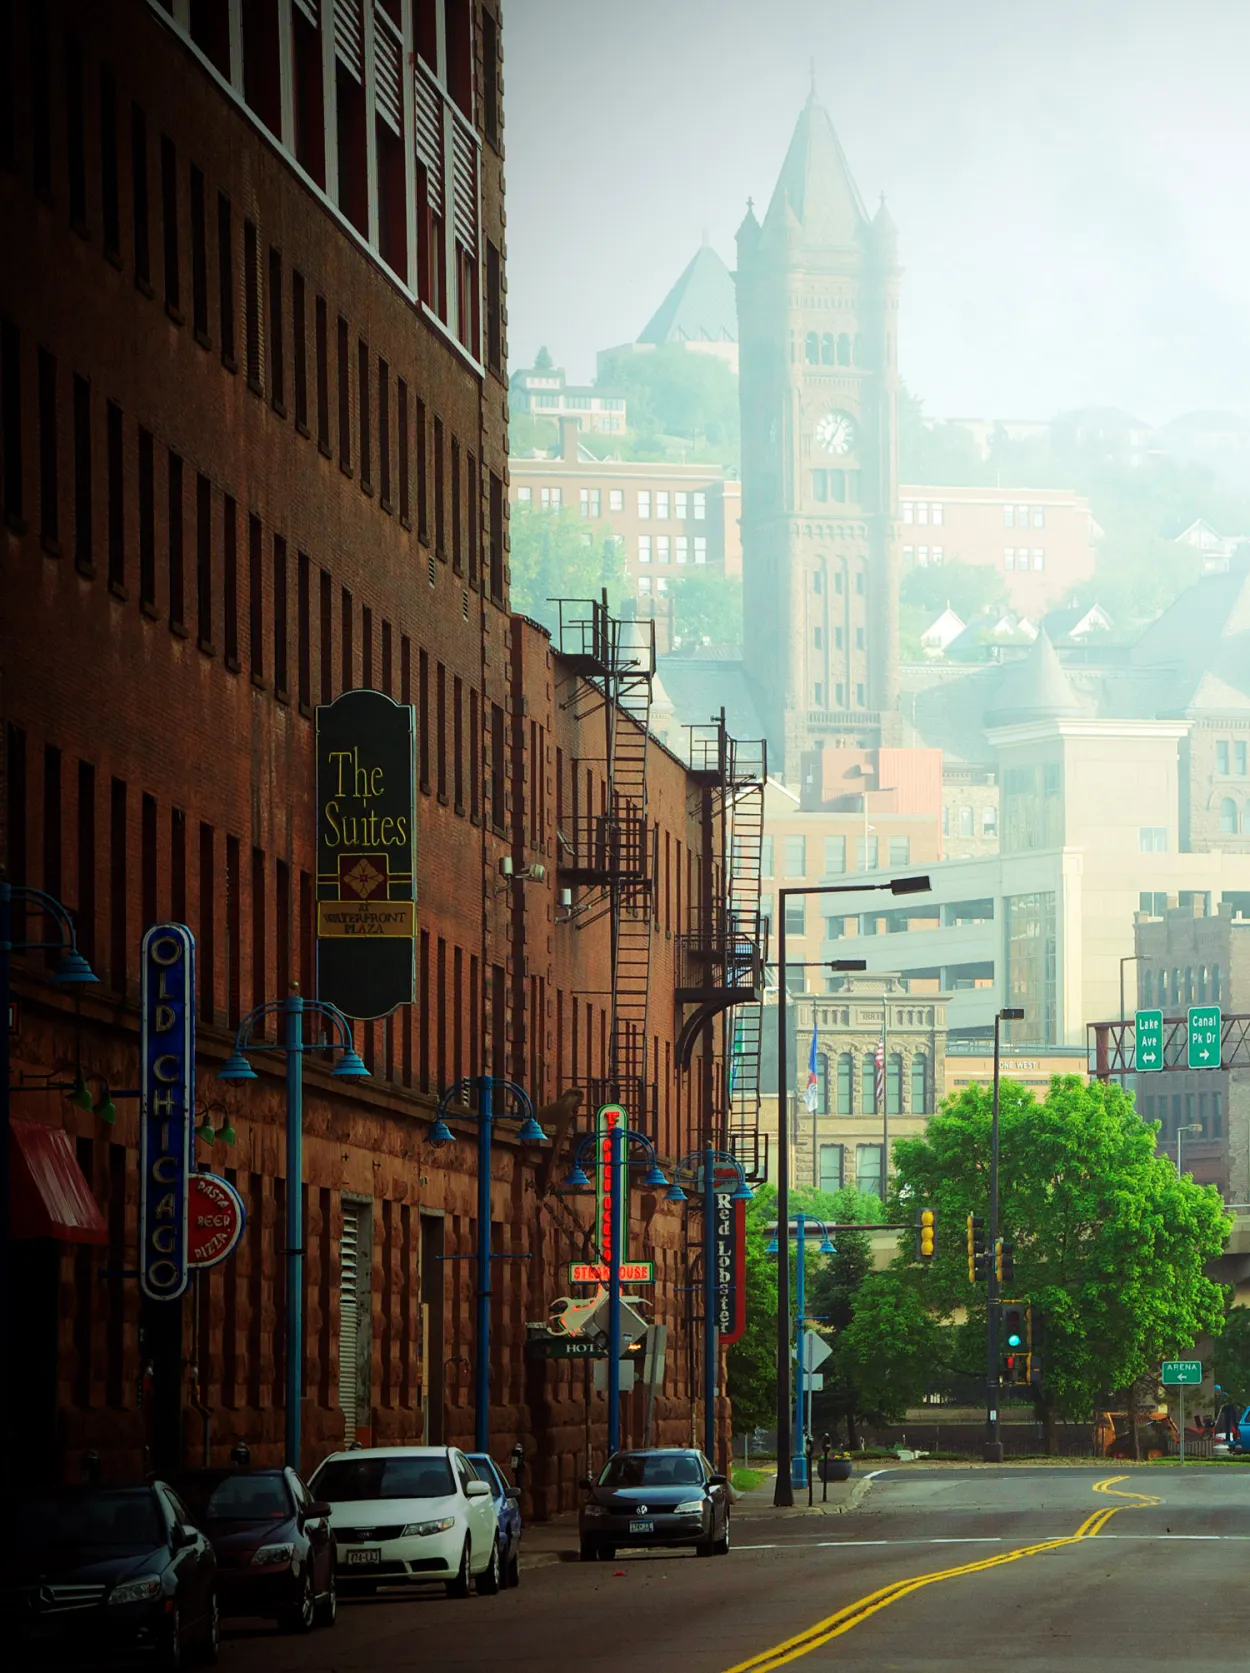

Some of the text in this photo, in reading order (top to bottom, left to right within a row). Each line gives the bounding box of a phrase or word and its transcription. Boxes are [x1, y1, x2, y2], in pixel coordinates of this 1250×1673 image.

[328, 747, 384, 798] The
[324, 799, 406, 847] Suites
[323, 911, 407, 923] WATERFRONT
[344, 923, 385, 934] PLAZA
[1139, 1018, 1159, 1030] Lake
[1192, 1015, 1217, 1027] Canal
[1141, 1036, 1158, 1047] Ave
[1192, 1032, 1217, 1044] Pk Dr
[1015, 1061, 1036, 1069] WEST
[148, 936, 182, 1289] OLD CHICAGO
[197, 1181, 230, 1208] PASTA
[196, 1213, 231, 1228] BEER
[194, 1232, 228, 1259] PIZZA
[716, 1193, 733, 1333] Red Lobster
[1166, 1363, 1198, 1371] ARENA
